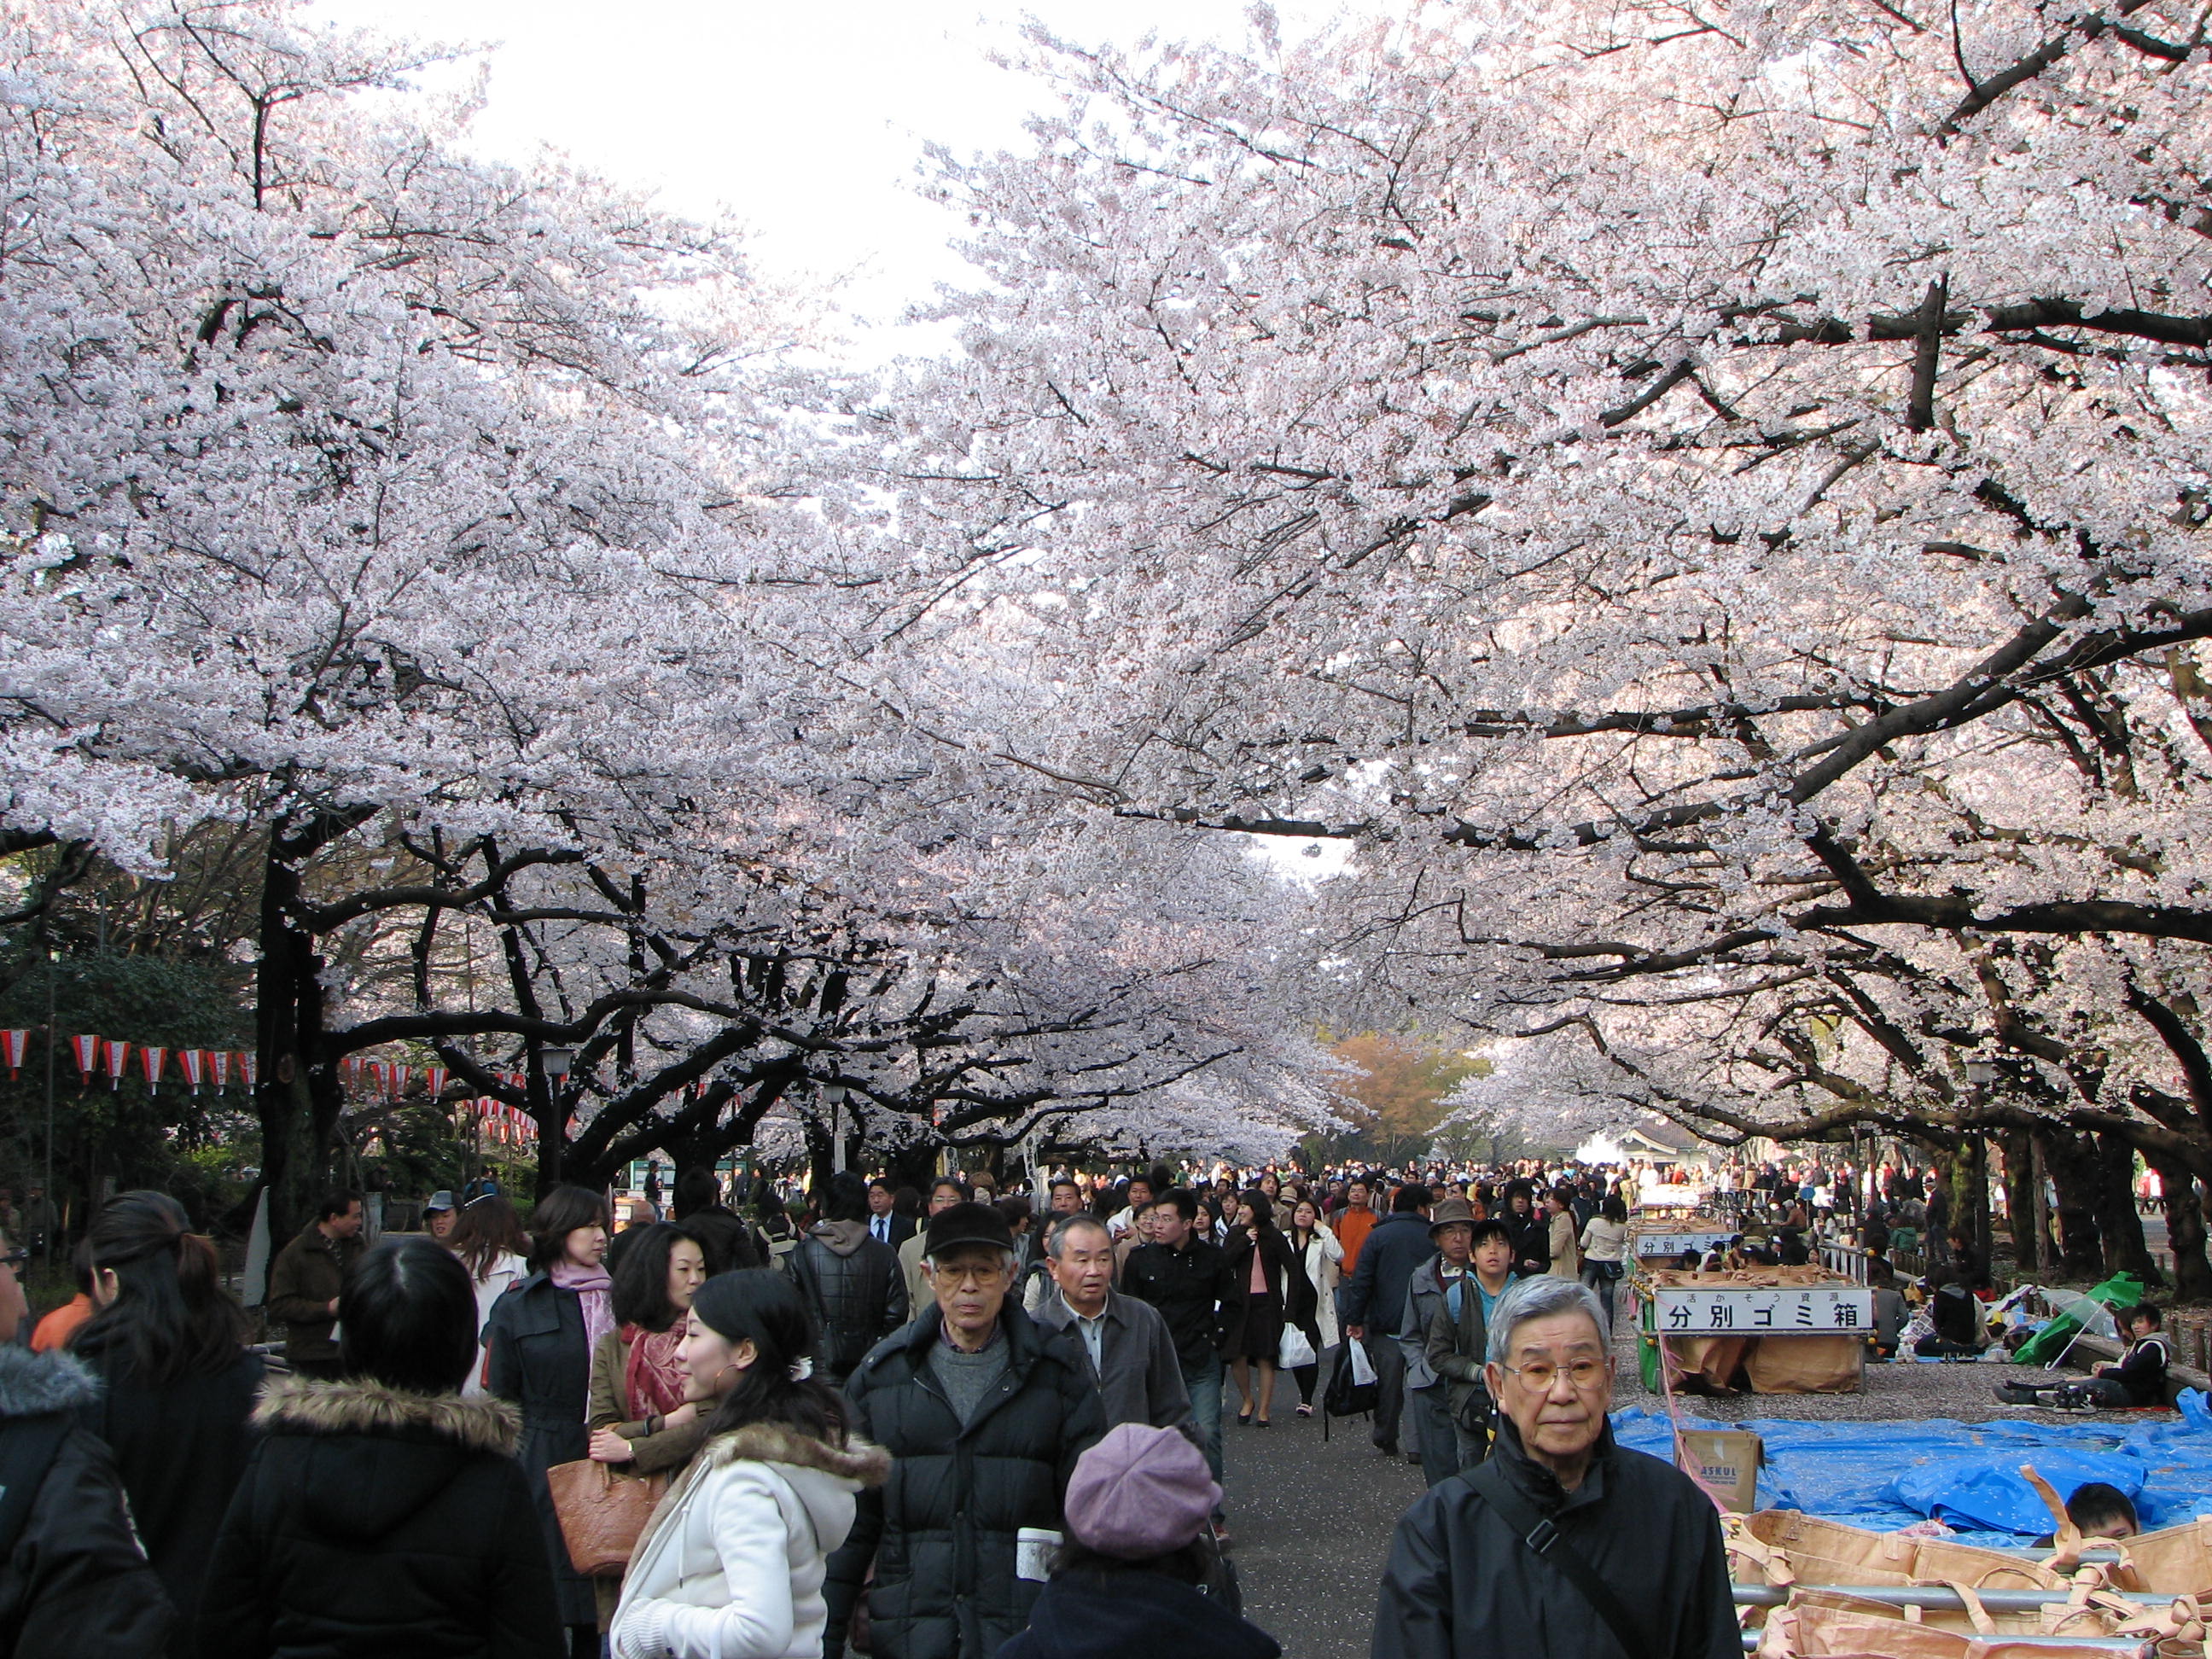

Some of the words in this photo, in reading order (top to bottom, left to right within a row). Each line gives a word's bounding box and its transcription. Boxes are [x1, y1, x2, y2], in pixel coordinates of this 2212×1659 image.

[1686, 1292, 1840, 1303] 活かそう資源
[1668, 1302, 1858, 1328] 分別ゴミ箱
[1701, 1466, 1737, 1476] ASKUL
